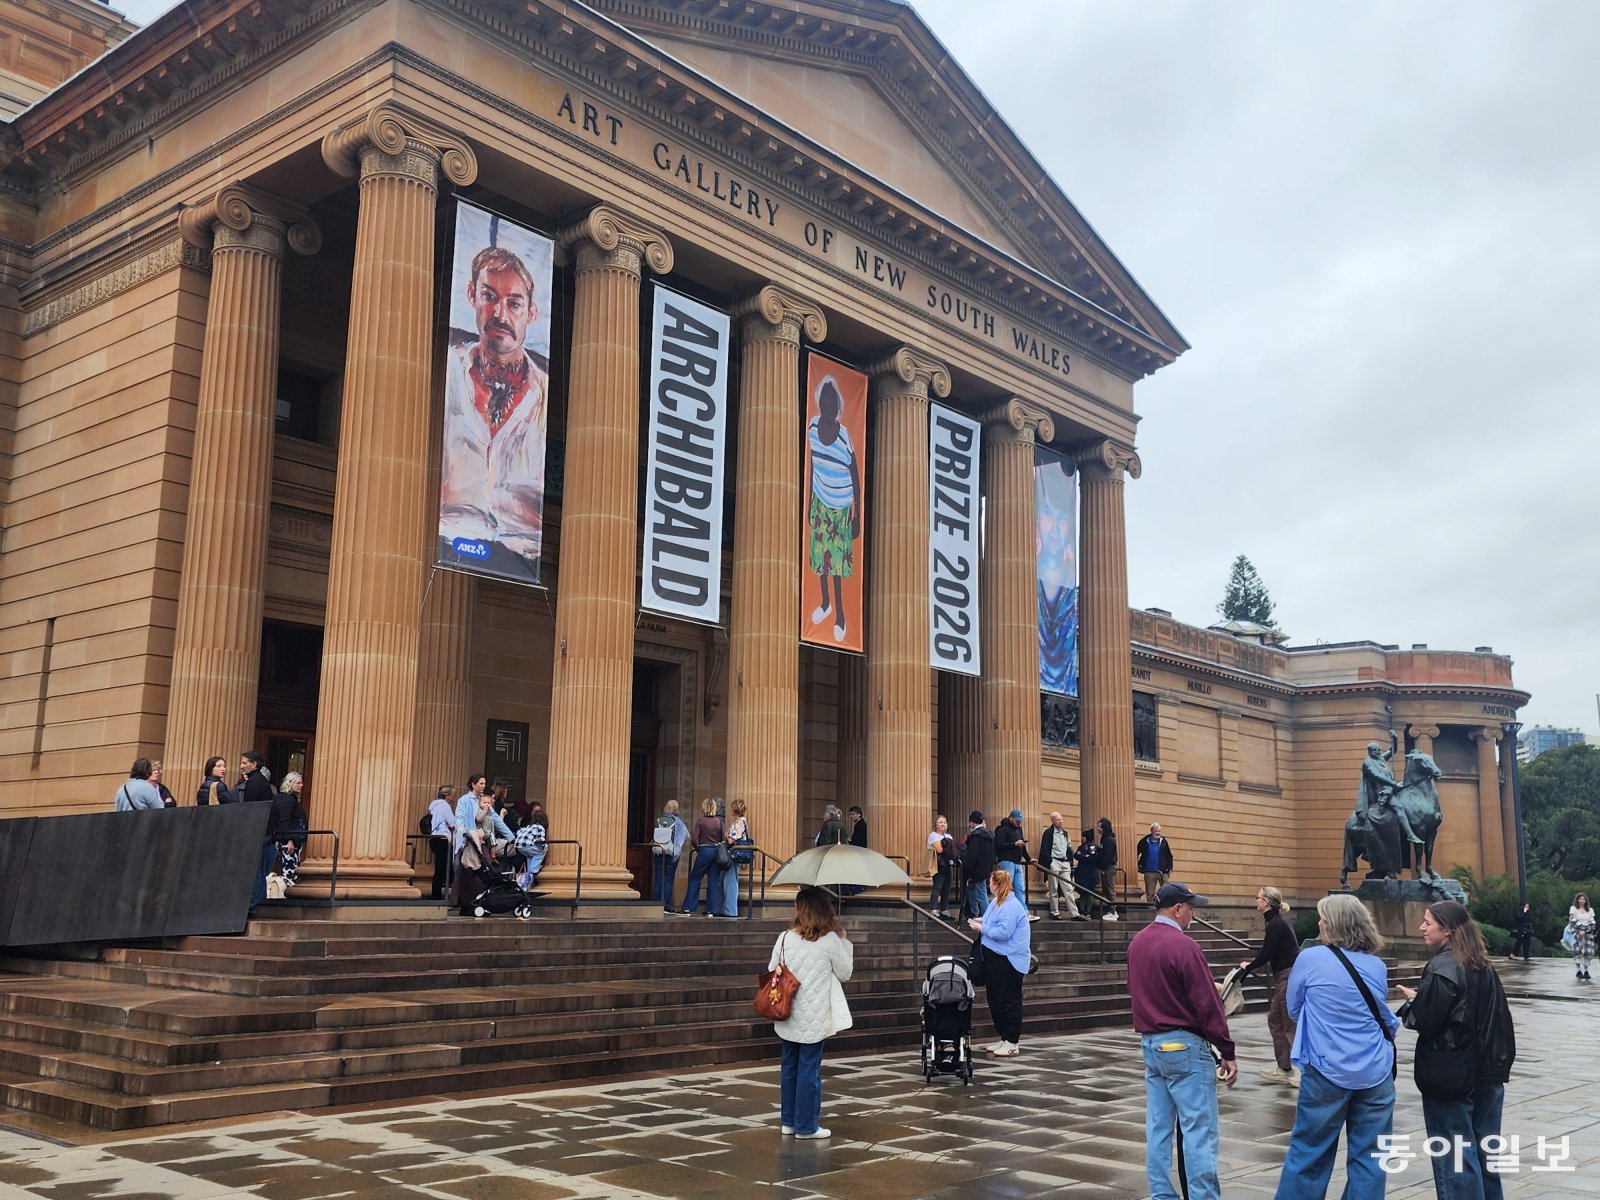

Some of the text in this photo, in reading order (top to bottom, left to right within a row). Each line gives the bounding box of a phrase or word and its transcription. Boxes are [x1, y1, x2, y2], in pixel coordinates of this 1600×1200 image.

[557, 92, 1071, 375] ART GALLERY OF NEW SOUTH WALES
[651, 302, 720, 607] ARCHIBALD
[457, 543, 477, 554] ANZ
[932, 415, 973, 664] PRIZE 2026
[1131, 667, 1151, 681] RANDT
[1187, 681, 1212, 695] MURILLO
